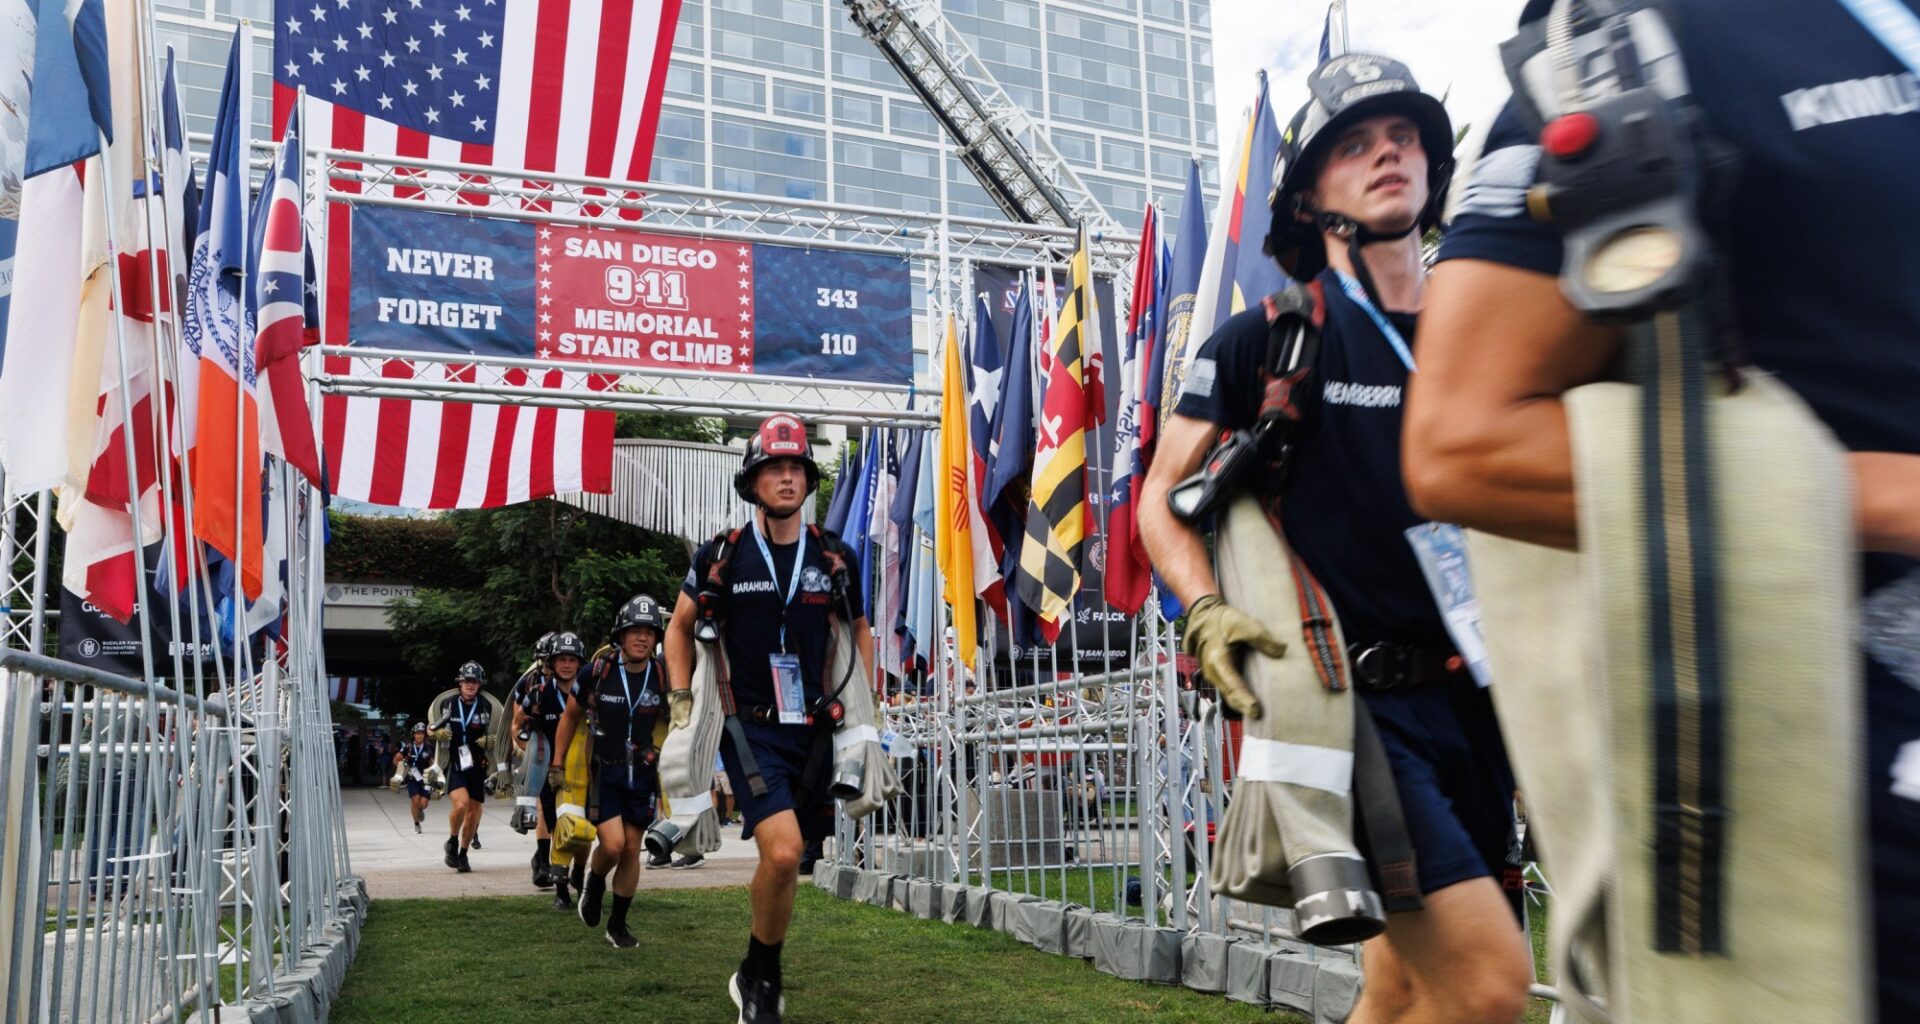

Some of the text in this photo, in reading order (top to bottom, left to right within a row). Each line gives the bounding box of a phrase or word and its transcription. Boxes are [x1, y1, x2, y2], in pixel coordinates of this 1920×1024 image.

[387, 247, 495, 281] NEVER
[564, 237, 717, 270] SAN DIEGO
[816, 287, 858, 309] 343
[377, 297, 502, 330] FORGET
[574, 308, 719, 339] MEMORIAL
[558, 332, 733, 365] STAIR CLIMB
[820, 333, 857, 356] 110
[343, 586, 369, 596] THE
[640, 602, 649, 613] 8
[564, 636, 572, 645] 8
